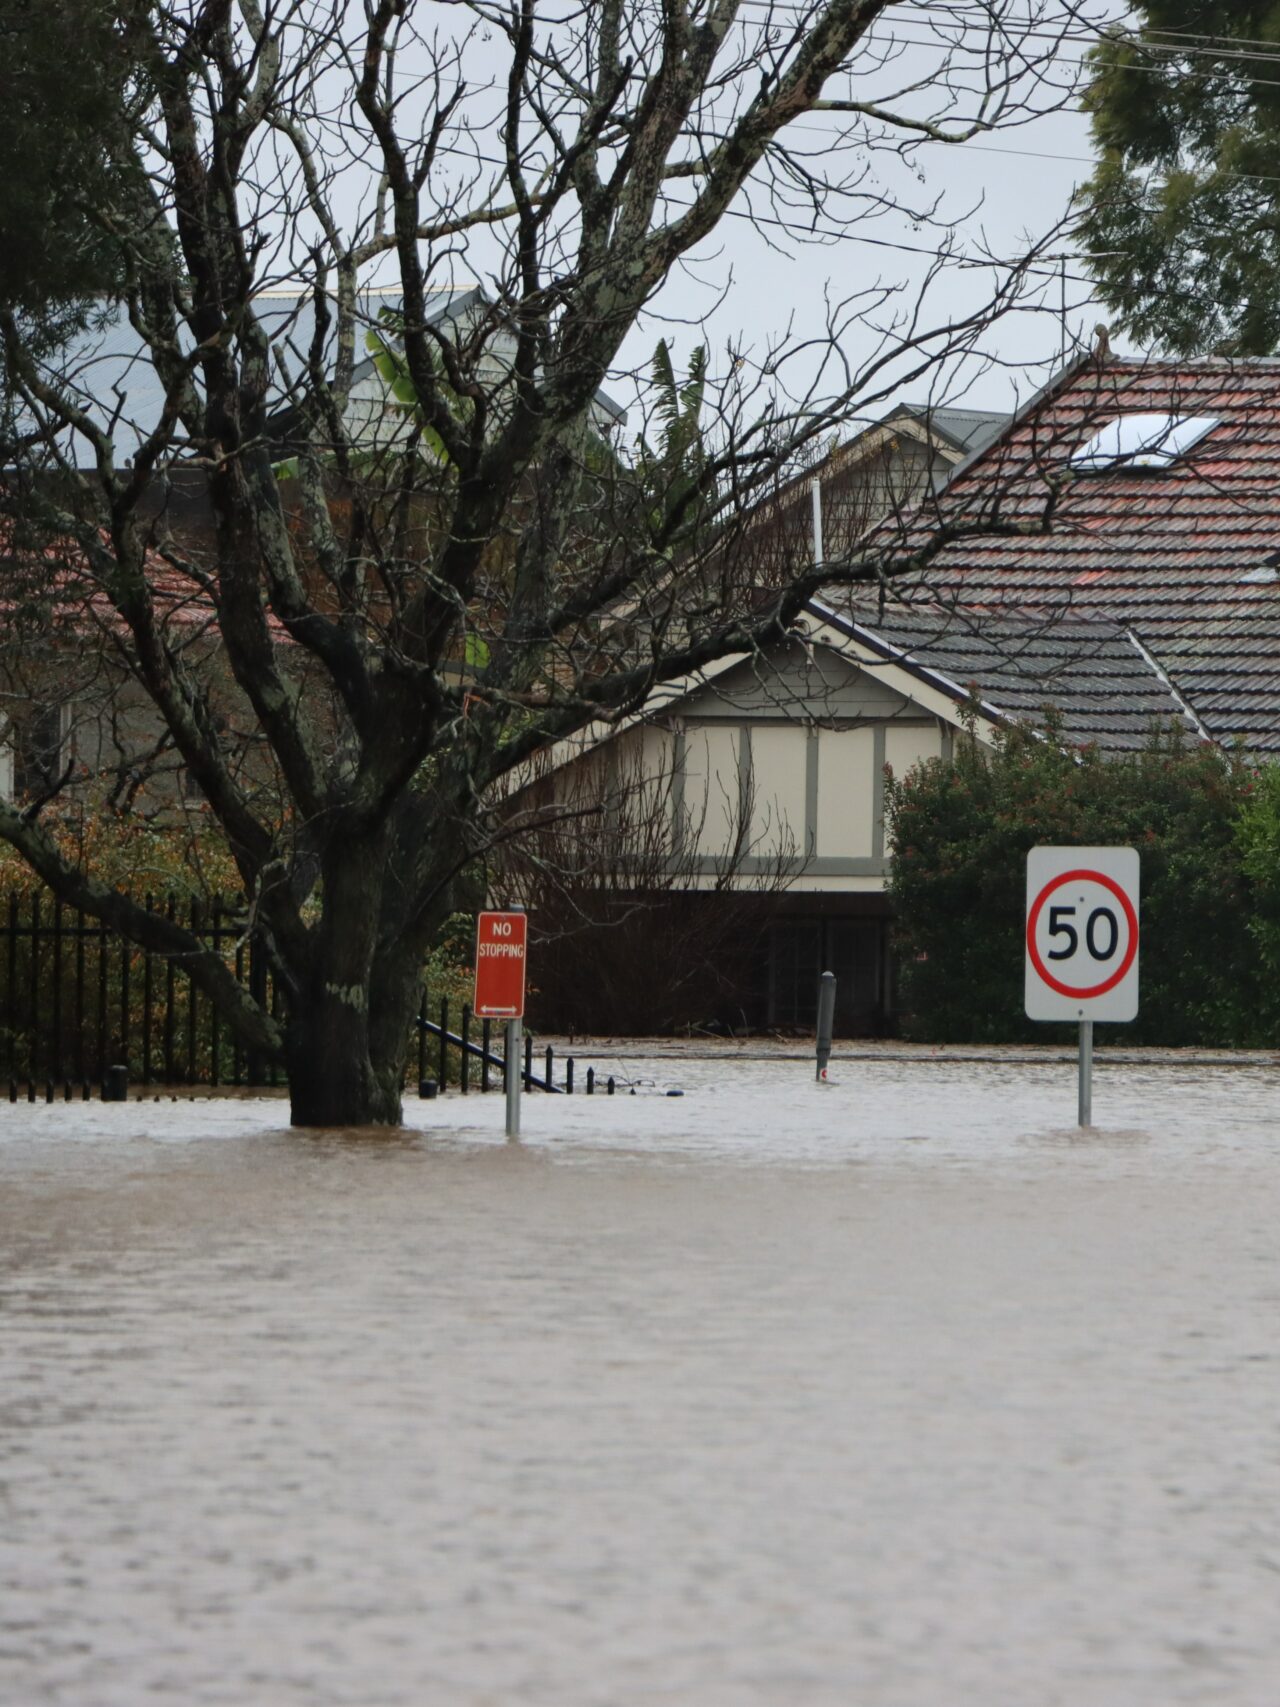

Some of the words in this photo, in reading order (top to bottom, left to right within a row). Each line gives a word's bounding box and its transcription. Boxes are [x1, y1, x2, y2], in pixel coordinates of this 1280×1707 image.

[492, 922, 512, 936] NO
[1048, 906, 1119, 961] 50
[479, 943, 524, 958] STOPPING
